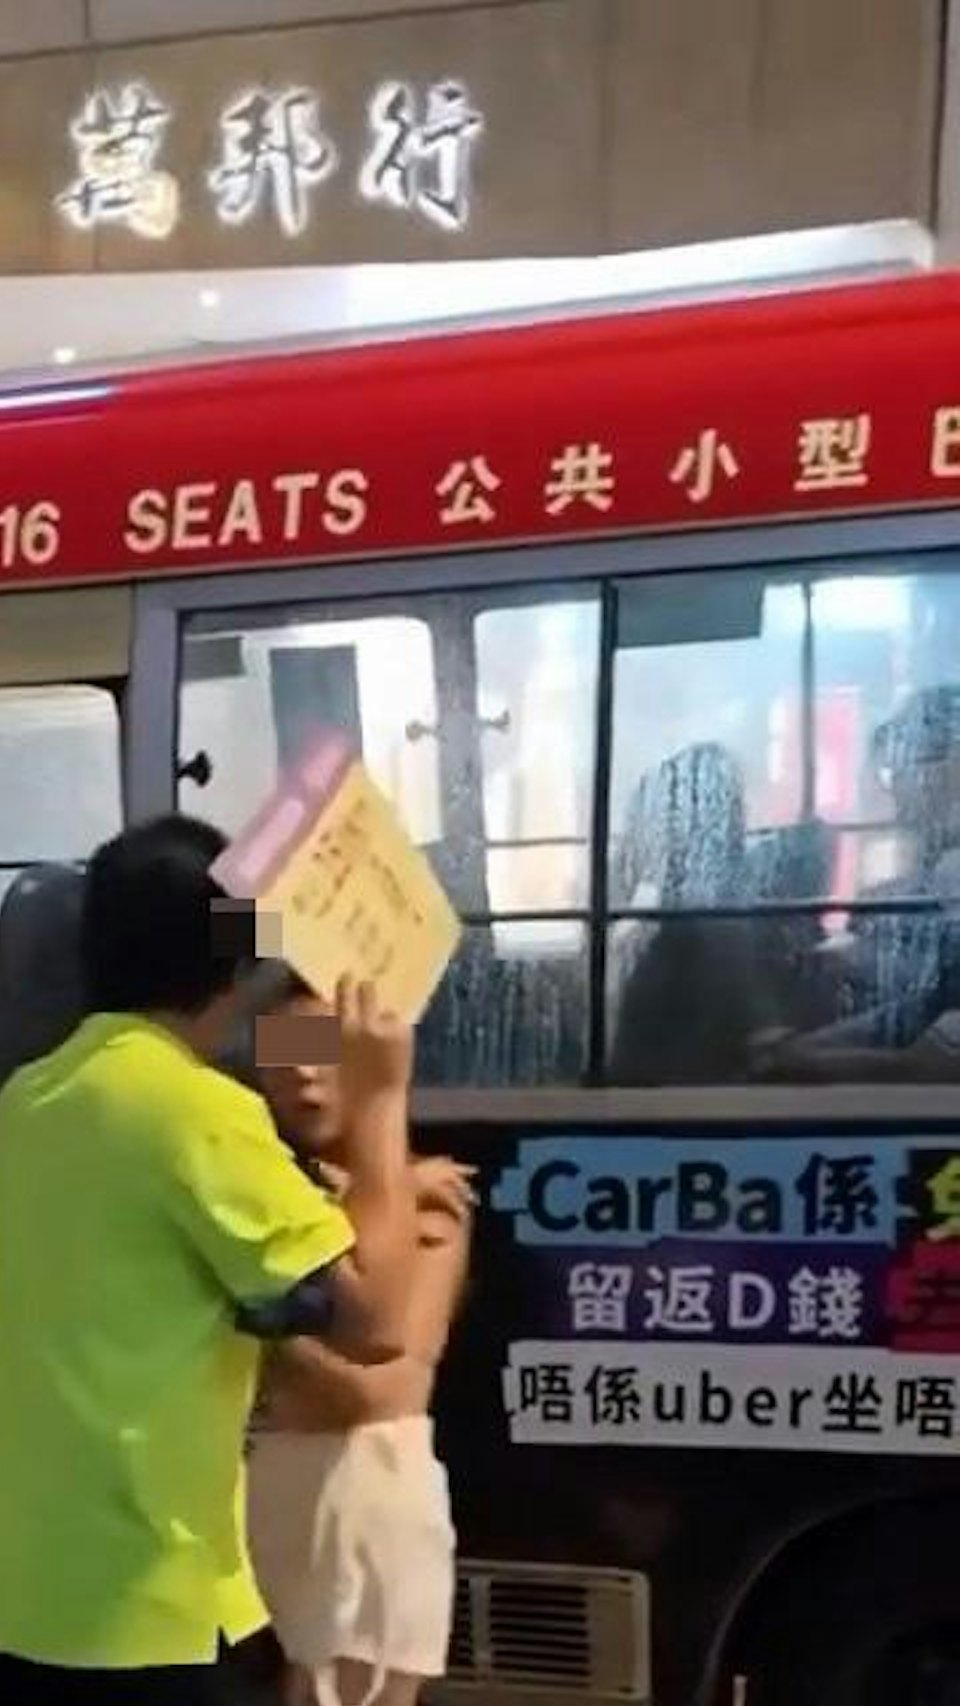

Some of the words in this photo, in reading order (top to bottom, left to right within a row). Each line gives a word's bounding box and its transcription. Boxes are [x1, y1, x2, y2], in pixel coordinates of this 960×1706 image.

[54, 80, 484, 240] 萬邦行
[122, 467, 370, 555] SEATS
[527, 1152, 879, 1235] CarBa係
[568, 1262, 865, 1338] 留返D錢
[519, 1364, 957, 1438] 唔係uber坐唔
